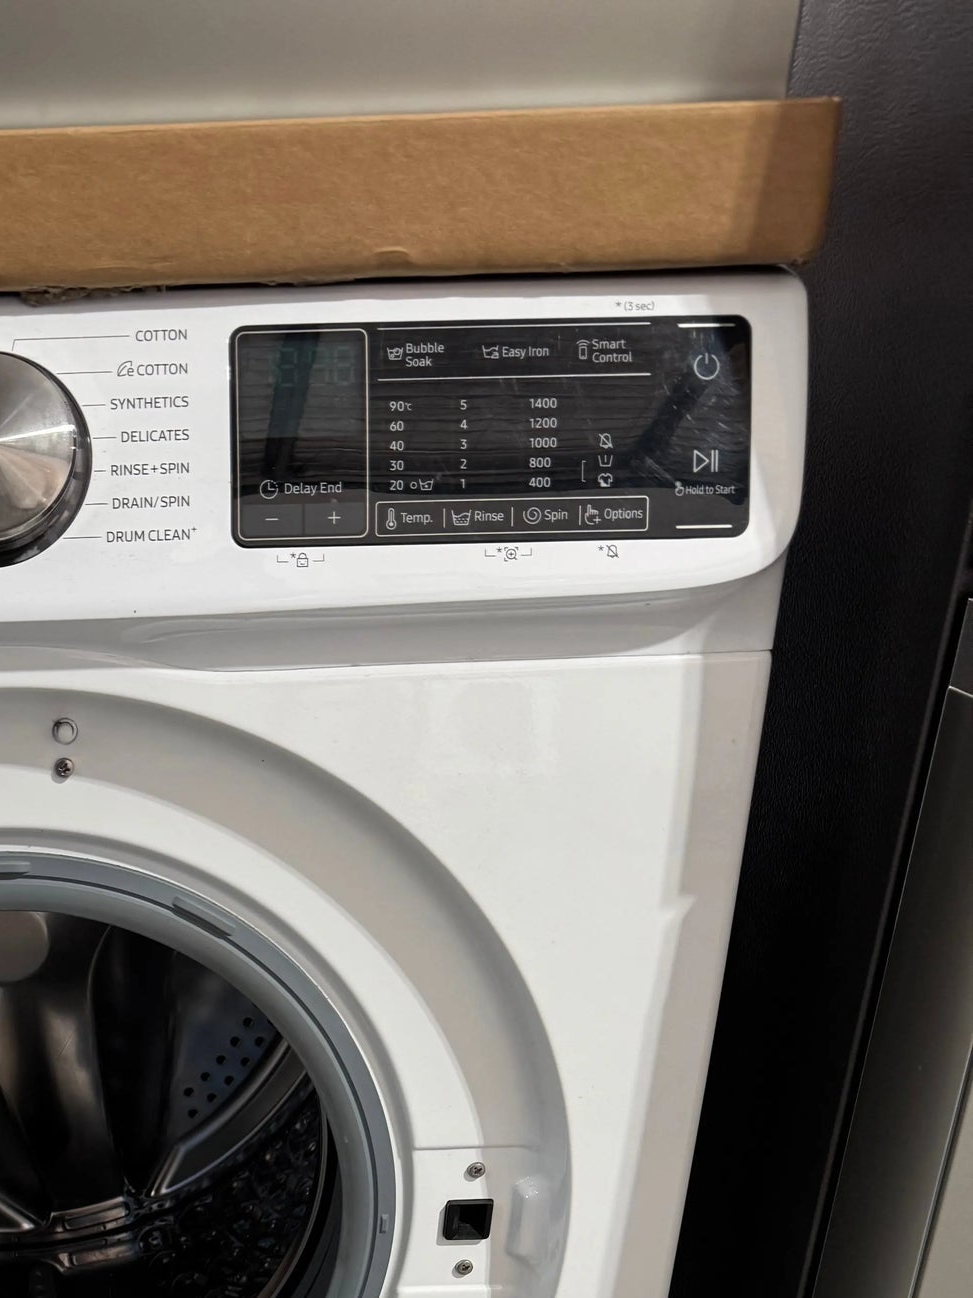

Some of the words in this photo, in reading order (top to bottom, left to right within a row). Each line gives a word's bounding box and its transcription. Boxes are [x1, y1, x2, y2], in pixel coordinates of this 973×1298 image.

[635, 301, 654, 311] sec)
[135, 329, 187, 342] COTTON
[406, 343, 444, 353] Bubble
[592, 340, 626, 349] Smart
[503, 347, 526, 359] Easy
[529, 346, 549, 356] Iron
[593, 352, 632, 362] Control
[406, 356, 432, 367] Soak
[137, 364, 188, 376] COTTON
[110, 396, 188, 410] SYNTHETICS
[460, 400, 467, 410] 5
[530, 399, 557, 408] 1400
[390, 422, 404, 431] 60
[460, 420, 467, 429] 4
[530, 418, 557, 428] 1200
[121, 429, 189, 443] DELICATES
[390, 441, 404, 451] 40
[461, 439, 467, 449] 3
[529, 438, 557, 448] 1000
[390, 461, 404, 470] 30
[461, 459, 467, 469] 2
[529, 458, 551, 468] 800
[111, 463, 190, 476] RINSE+SPIN
[390, 481, 404, 490] 20
[461, 479, 466, 489] 1
[529, 478, 551, 487] 400
[285, 483, 315, 496] Delay
[320, 482, 342, 493] End
[685, 485, 704, 495] Hold
[705, 486, 714, 494] to
[715, 485, 735, 494] Start
[112, 495, 190, 510] DRAIN/SPIN
[475, 511, 504, 522] Rinse
[544, 510, 568, 522] Spin
[604, 508, 643, 520] Options
[401, 513, 433, 526] Temp.
[107, 530, 145, 543] DRUM
